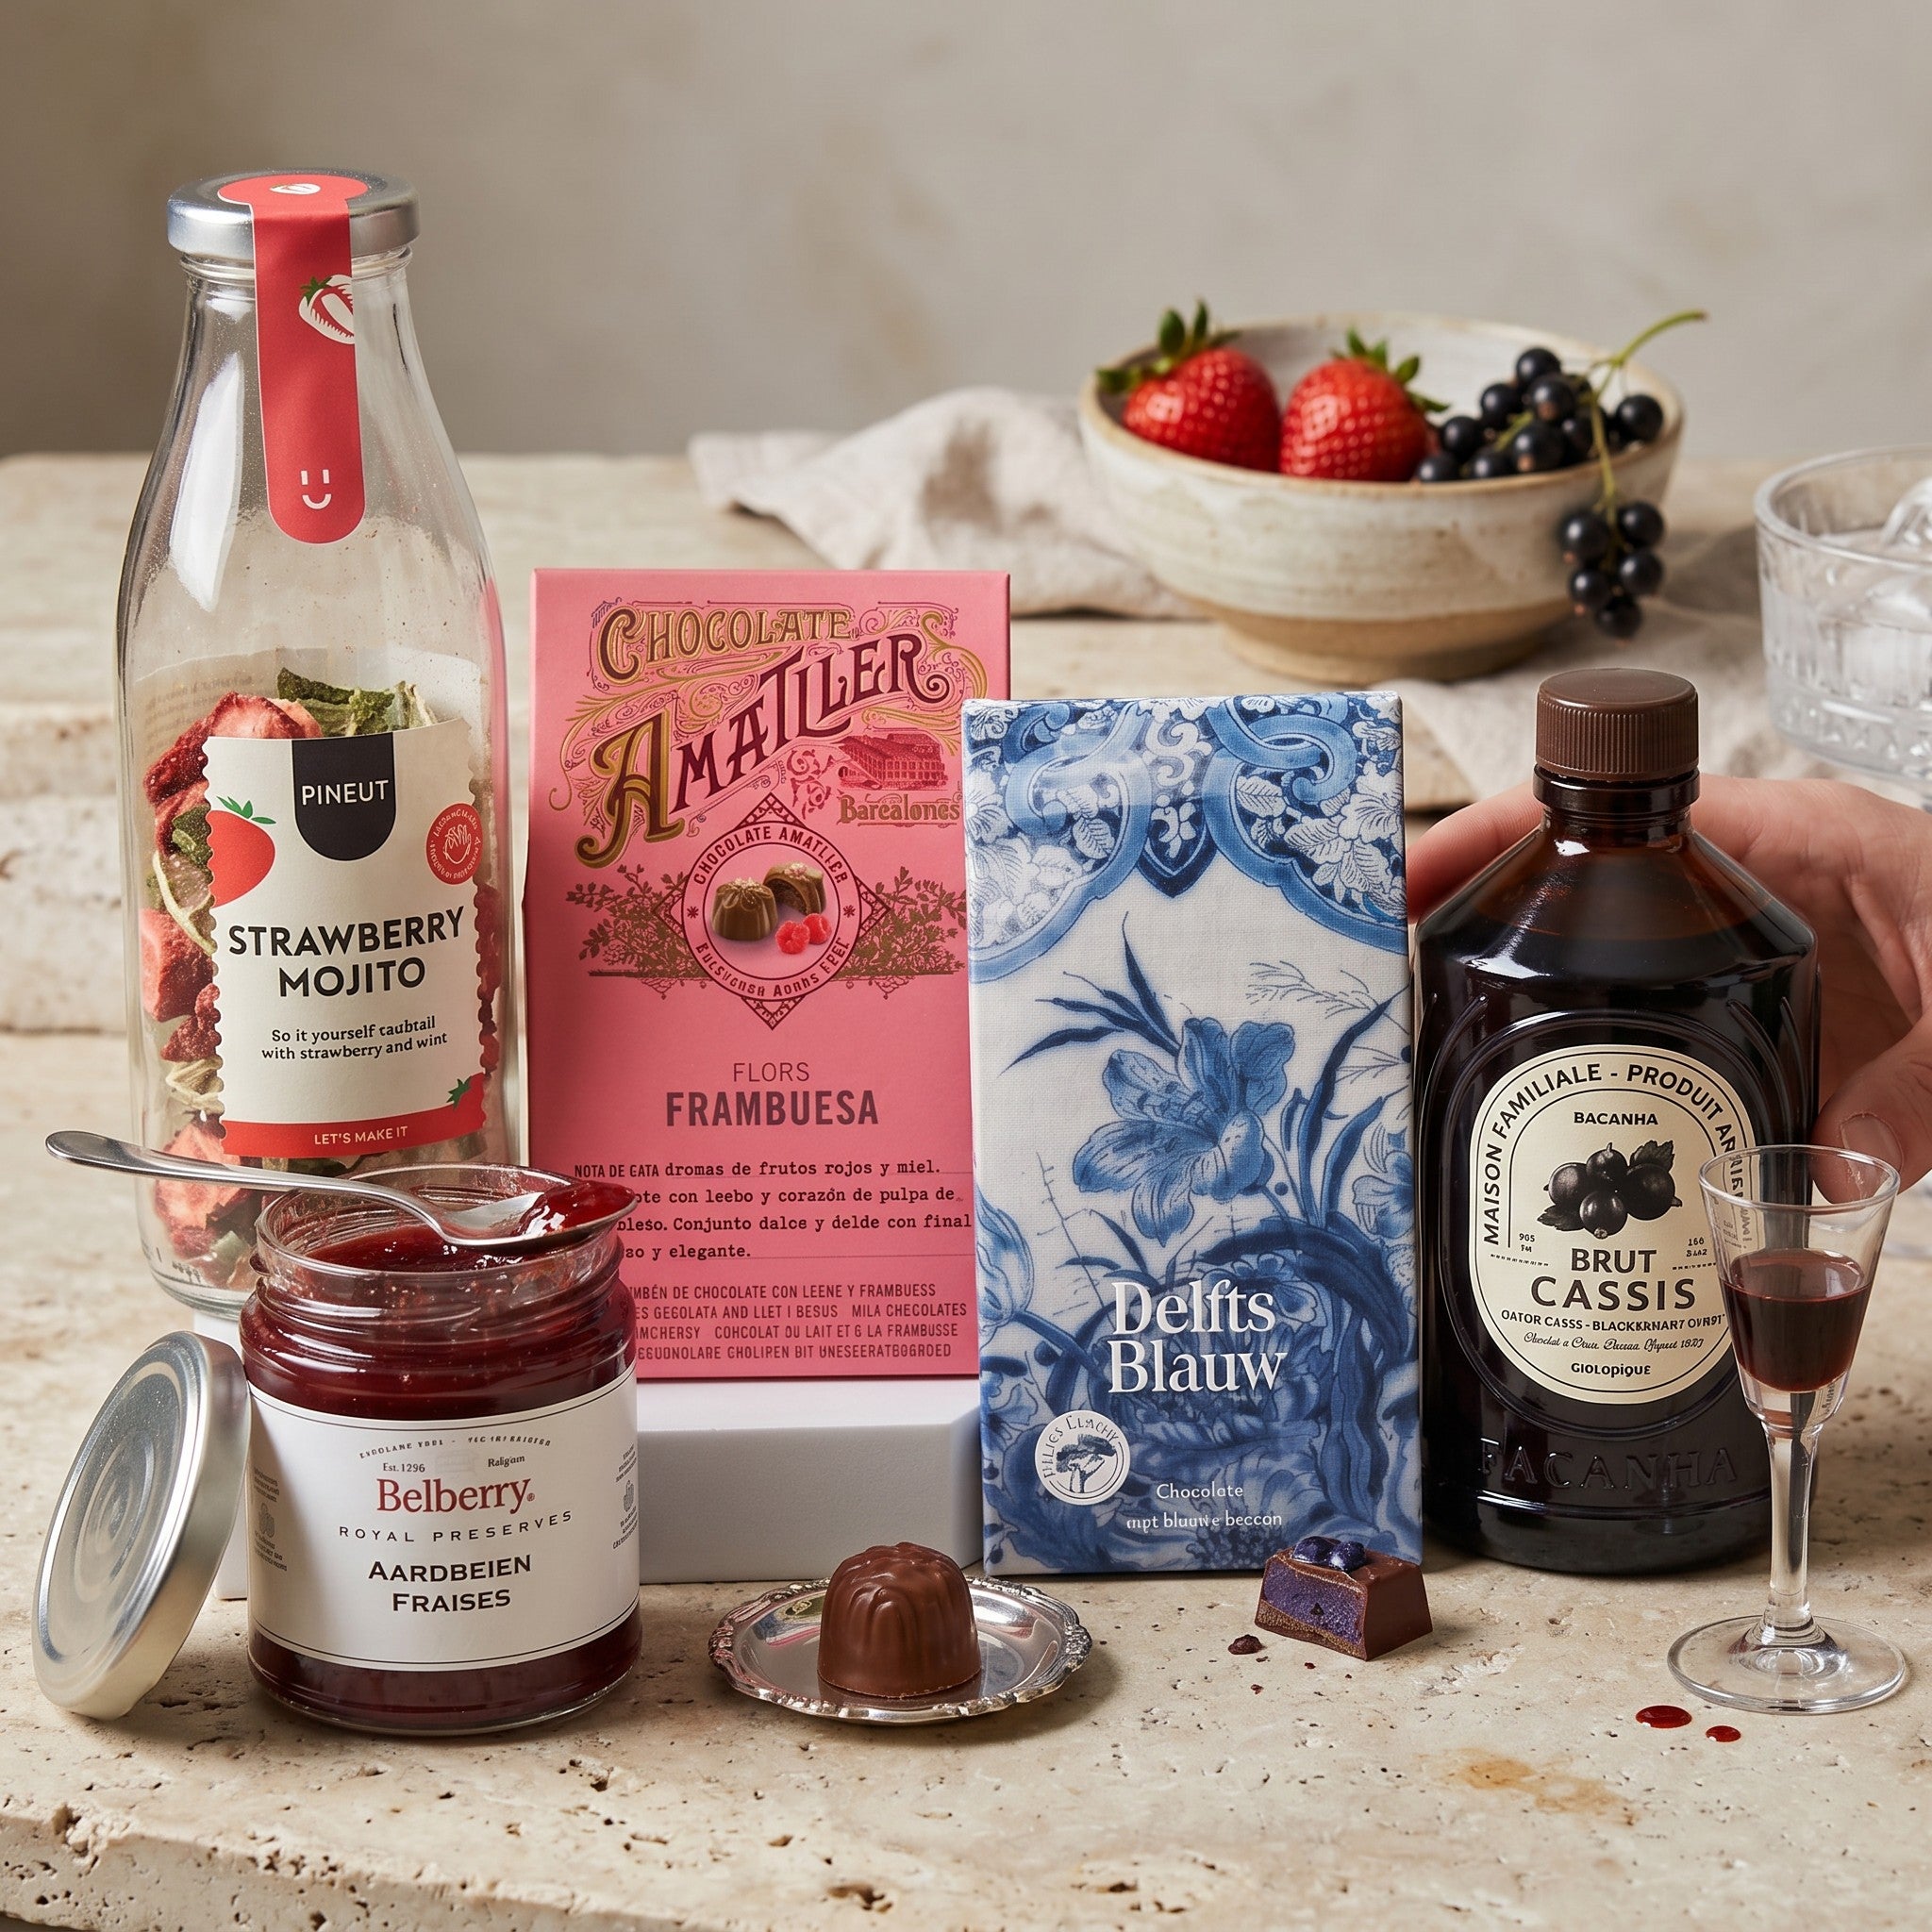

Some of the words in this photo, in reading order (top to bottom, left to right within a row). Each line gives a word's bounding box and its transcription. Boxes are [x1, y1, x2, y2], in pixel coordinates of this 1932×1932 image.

[596, 608, 853, 686] CHOCOLATE
[576, 633, 950, 868] AMATLLER
[301, 779, 389, 806] PINEUT
[693, 825, 772, 885] CHOCOLATE
[228, 906, 465, 957] STRAWBERRY
[278, 957, 426, 997] MOJITO
[261, 1046, 295, 1059] with
[300, 1044, 383, 1059] strawberry
[386, 1038, 413, 1054] and
[416, 1032, 448, 1049] wint
[272, 1029, 291, 1042] So
[295, 1028, 308, 1042] it
[311, 1024, 376, 1044] yourself
[733, 1062, 810, 1083] FLORS
[665, 1090, 879, 1127] FRAMBUESA
[1574, 1112, 1658, 1126] BACANHA
[314, 1132, 352, 1145] LET'S
[355, 1127, 393, 1143] MAKE
[396, 1125, 408, 1138] IT
[1483, 1143, 1503, 1246] MAISON
[1493, 1063, 1602, 1140] FAMILIALE
[1626, 1064, 1724, 1121] PRODUIT
[575, 1164, 606, 1177] NOTA
[609, 1164, 625, 1177] DE
[665, 1162, 724, 1175] dromas
[731, 1162, 752, 1175] de
[758, 1161, 817, 1175] frutos
[824, 1161, 873, 1176] rojos
[880, 1163, 890, 1176] y
[897, 1159, 941, 1174] miel.
[669, 1192, 698, 1203] con
[707, 1190, 754, 1203] leebo
[761, 1192, 771, 1205] y
[778, 1188, 846, 1202] corazón
[853, 1188, 873, 1201] de
[880, 1188, 929, 1204] pulpa
[935, 1187, 955, 1200] de
[674, 1217, 752, 1232] Conjunto
[815, 1218, 824, 1232] y
[887, 1217, 917, 1228] con
[924, 1213, 972, 1228] final
[652, 1248, 662, 1260] y
[669, 1243, 751, 1260] elegante.
[1571, 1248, 1657, 1274] BRUT
[674, 1286, 690, 1299] DE
[694, 1286, 767, 1299] CHOCOLATE
[772, 1286, 798, 1298] CON
[803, 1285, 842, 1298] LEENE
[847, 1285, 855, 1298] Y
[859, 1284, 936, 1297] FRAMBUESS
[1531, 1276, 1696, 1312] CASSIS
[723, 1306, 749, 1319] AND
[755, 1306, 782, 1318] LLET
[796, 1305, 838, 1318] BESUS
[852, 1304, 881, 1317] MILA
[1111, 1279, 1276, 1335] Delfts
[806, 1324, 832, 1338] LAIT
[837, 1324, 850, 1338] ET
[867, 1324, 883, 1338] LA
[888, 1324, 958, 1337] FRAMBUSSE
[795, 1346, 814, 1358] BIT
[1108, 1339, 1288, 1393] Blauw
[383, 1463, 399, 1473] Est.
[1157, 1481, 1244, 1499] Chocolate
[339, 1526, 415, 1542] ROYAL
[432, 1511, 573, 1542] PRESERVES
[368, 1554, 532, 1583] AARDBEIEN
[392, 1589, 511, 1612] FRAISES
